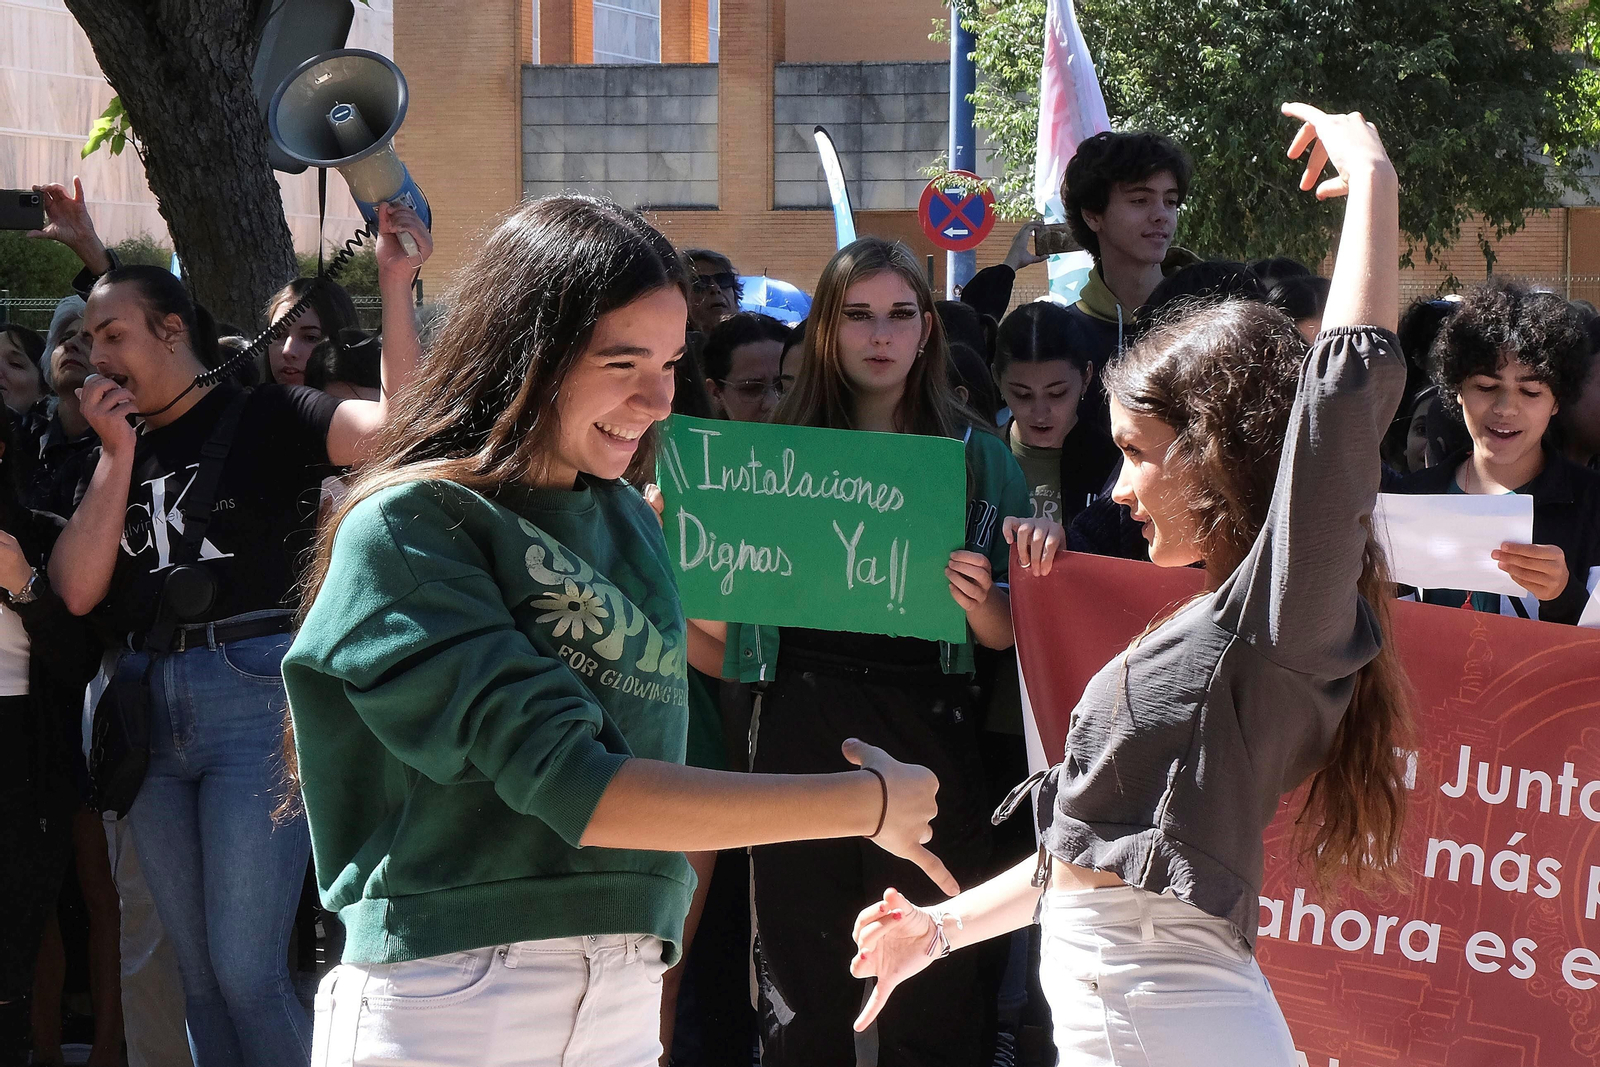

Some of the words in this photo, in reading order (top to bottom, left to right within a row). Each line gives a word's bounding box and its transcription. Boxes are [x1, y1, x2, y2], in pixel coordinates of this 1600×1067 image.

[956, 145, 964, 156] 7
[121, 518, 153, 541] alvin
[676, 505, 792, 595] Dignas
[832, 519, 909, 615] Ya!!
[558, 643, 599, 677] FOR
[599, 668, 672, 704] GLOWING
[1424, 831, 1563, 899] más
[1257, 887, 1442, 964] ahora
[1465, 930, 1539, 980] es
